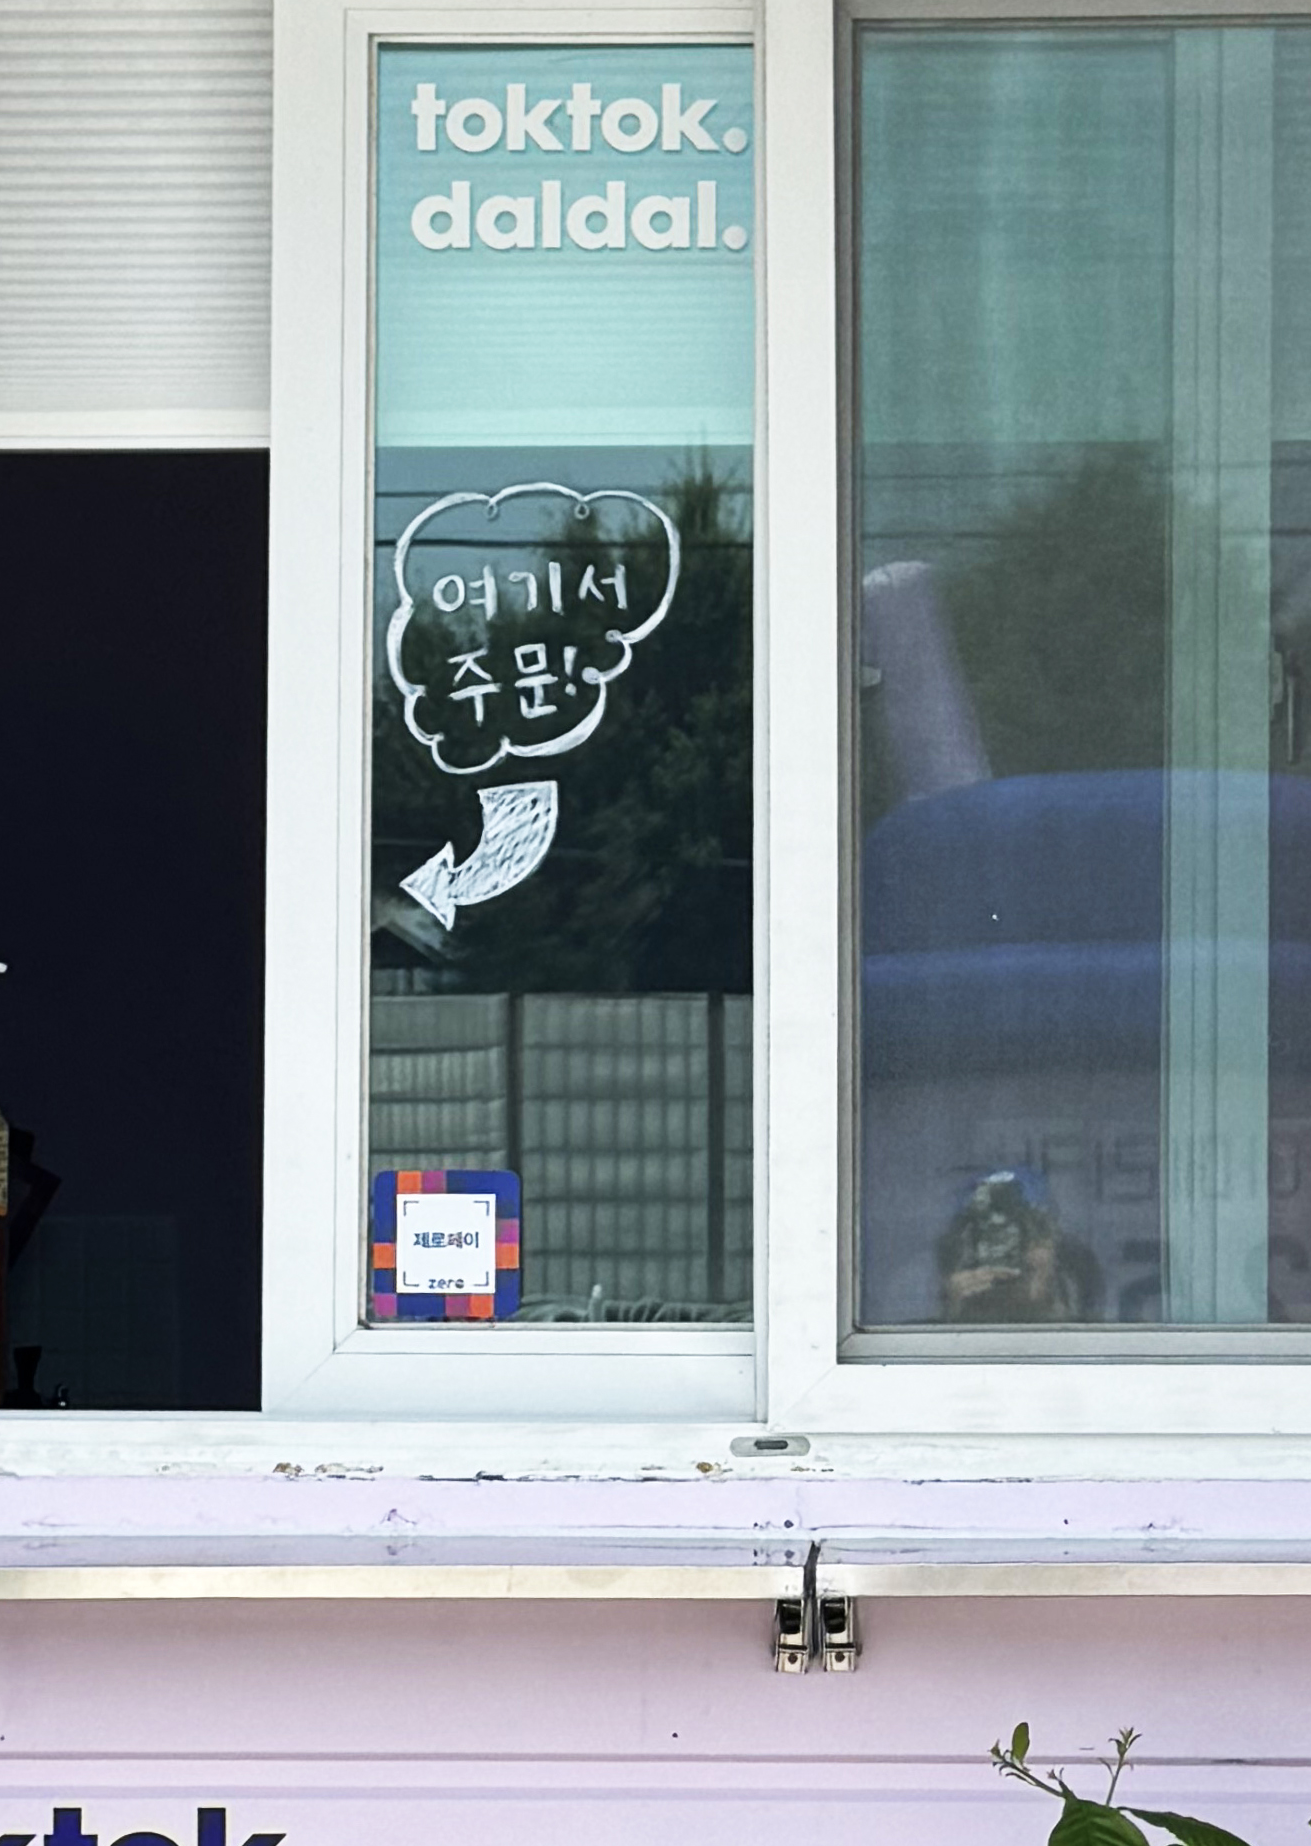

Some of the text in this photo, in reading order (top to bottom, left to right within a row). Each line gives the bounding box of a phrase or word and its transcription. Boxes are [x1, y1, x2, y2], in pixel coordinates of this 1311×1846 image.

[411, 83, 749, 153] toktok.
[411, 181, 749, 251] daldal.
[433, 561, 628, 621] 여기서
[448, 642, 579, 727] 주문!
